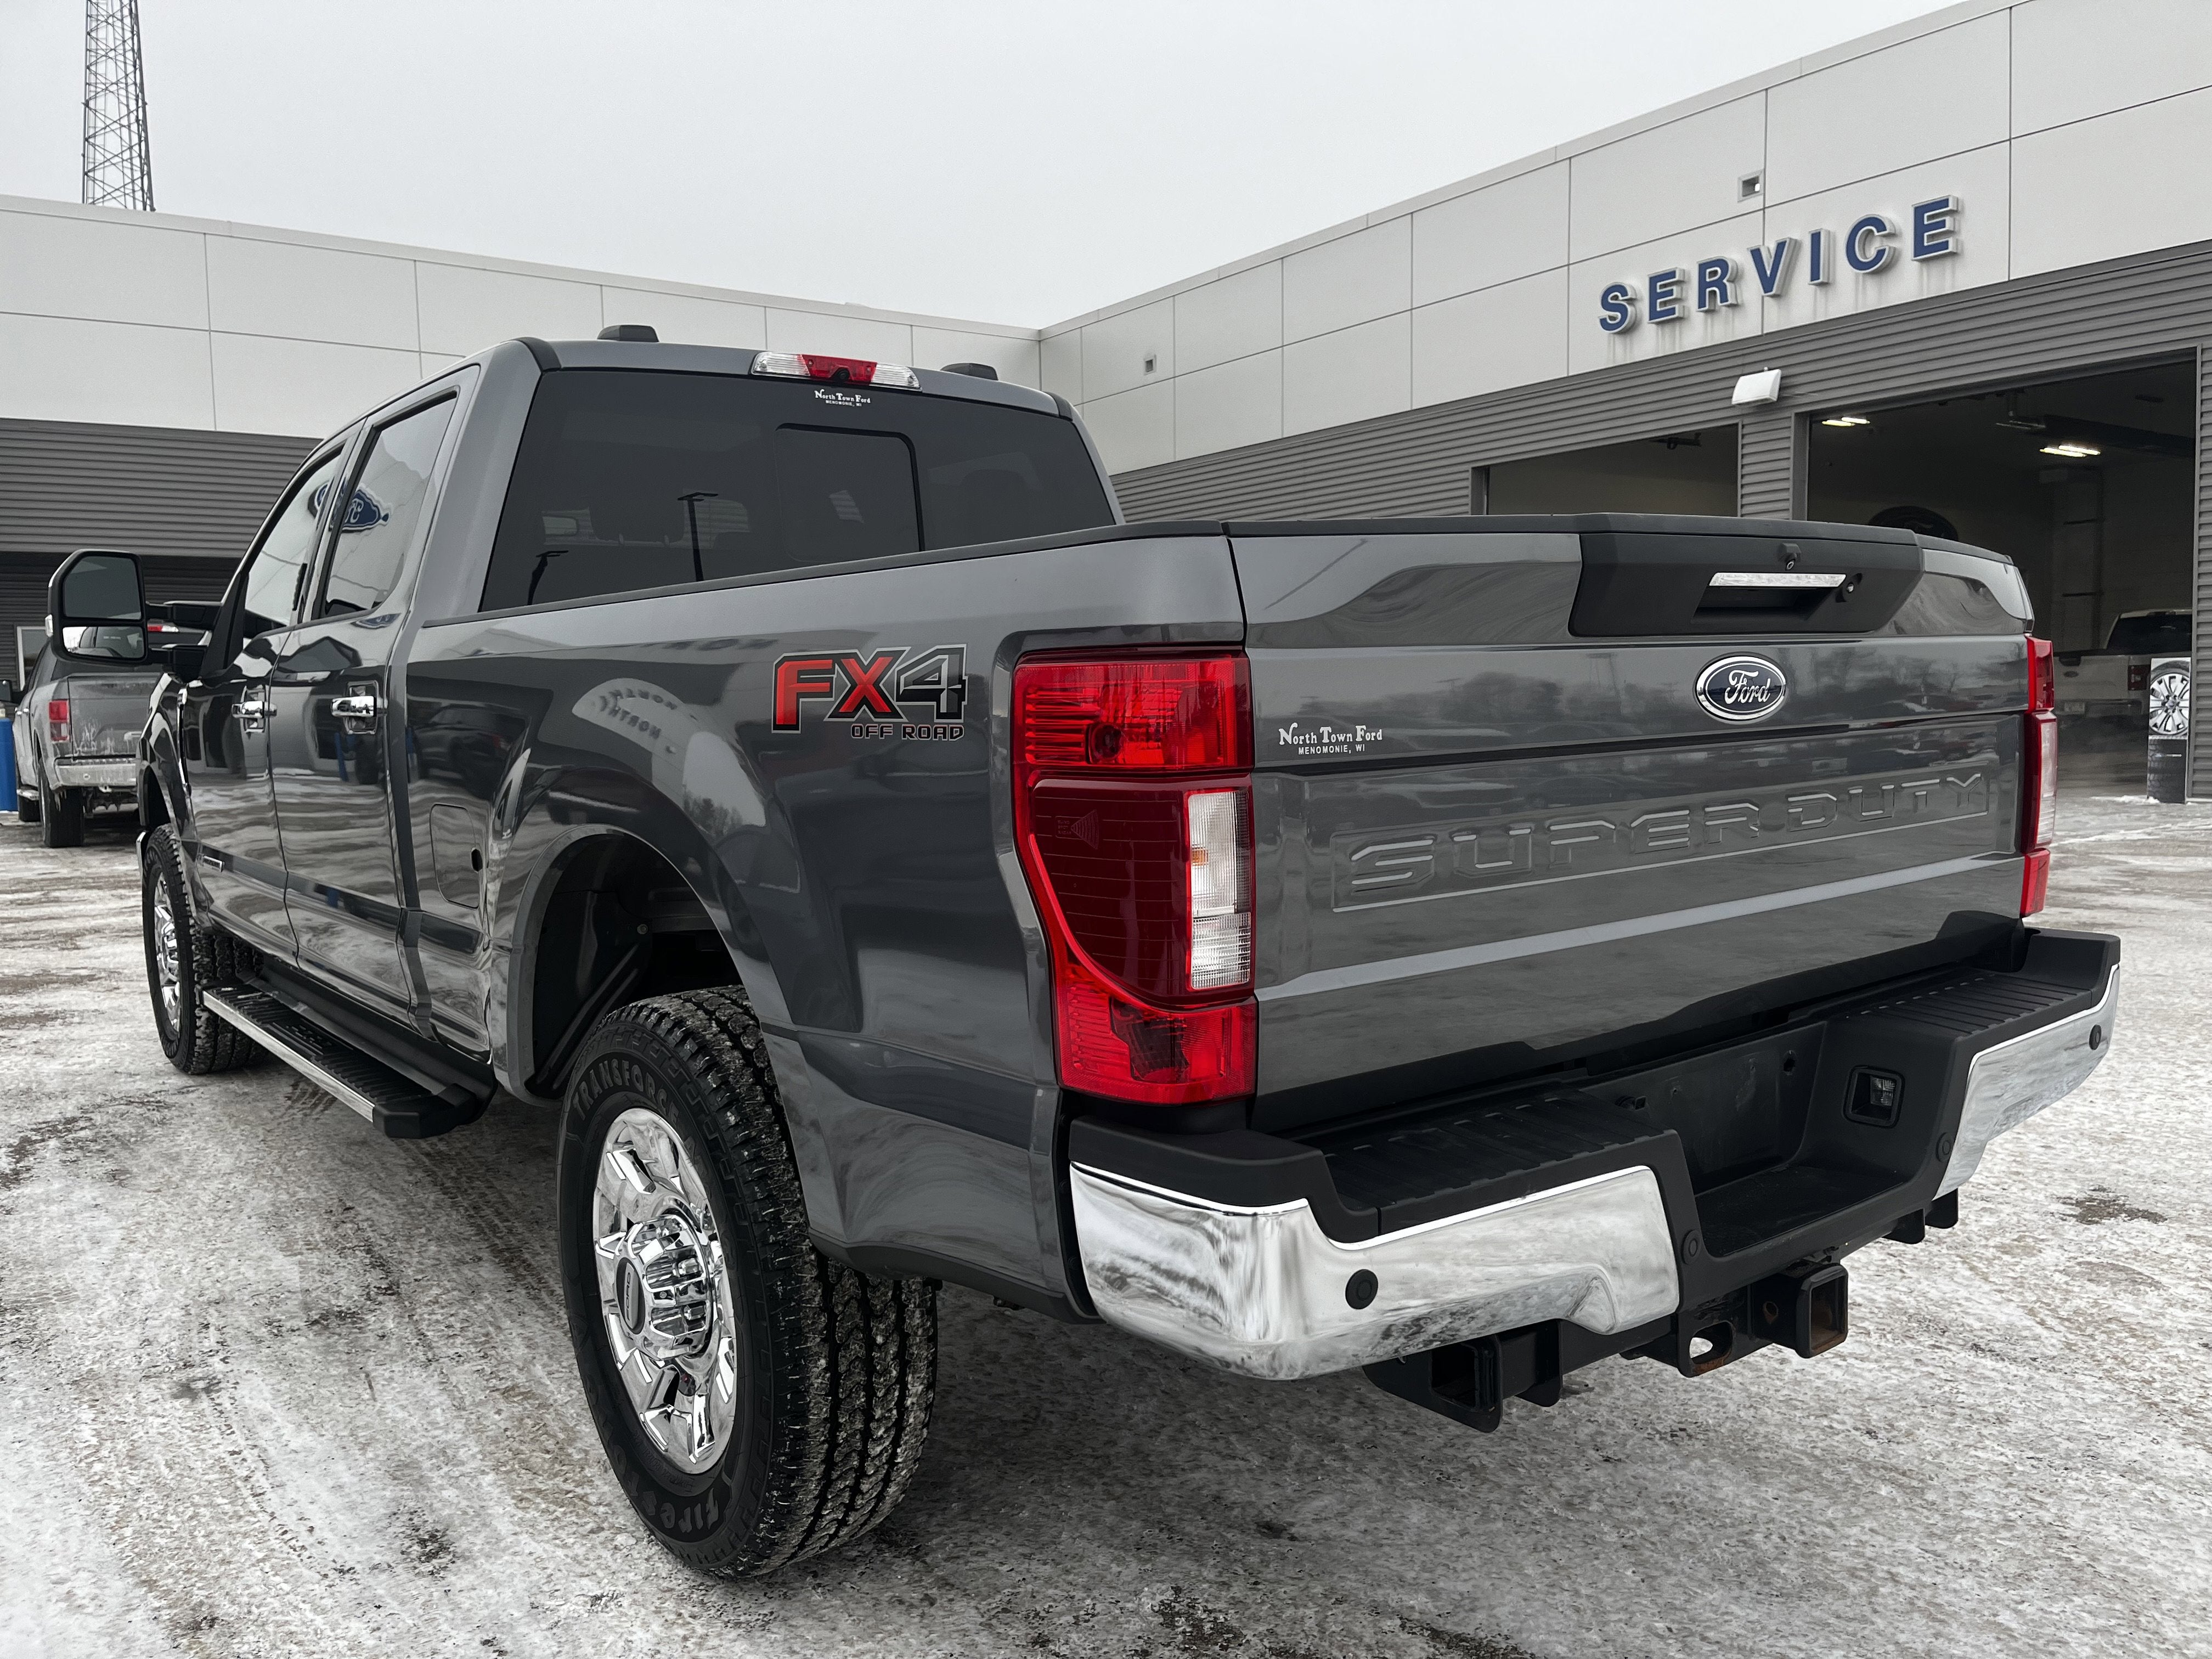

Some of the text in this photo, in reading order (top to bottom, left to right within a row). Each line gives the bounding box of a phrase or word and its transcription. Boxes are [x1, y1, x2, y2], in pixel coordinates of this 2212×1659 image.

[1598, 195, 1959, 334] SERVICE
[814, 389, 871, 403] North Town Ford
[771, 644, 968, 733] FX4
[1724, 670, 1771, 704] Ford
[850, 723, 964, 741] OFF ROAD
[1278, 722, 1383, 745] North Town Ford
[1298, 744, 1365, 755] MENOMONIE, WI
[1349, 772, 1982, 894] SUPER DUTY
[573, 1058, 680, 1125] TRANSFORCE
